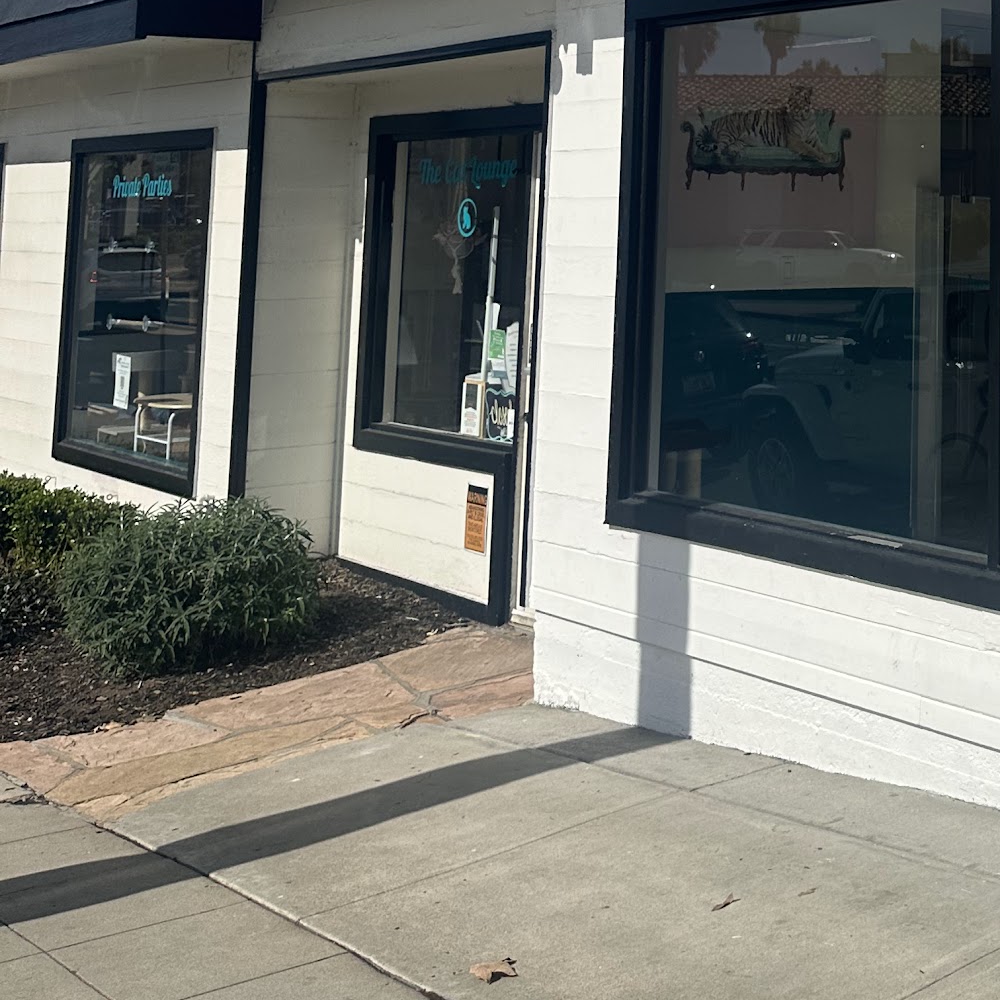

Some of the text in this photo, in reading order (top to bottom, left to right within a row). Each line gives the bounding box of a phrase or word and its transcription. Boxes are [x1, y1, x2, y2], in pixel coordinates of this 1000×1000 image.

[113, 173, 172, 198] Private Parties
[420, 157, 441, 184] The
[470, 154, 517, 189] Lounge
